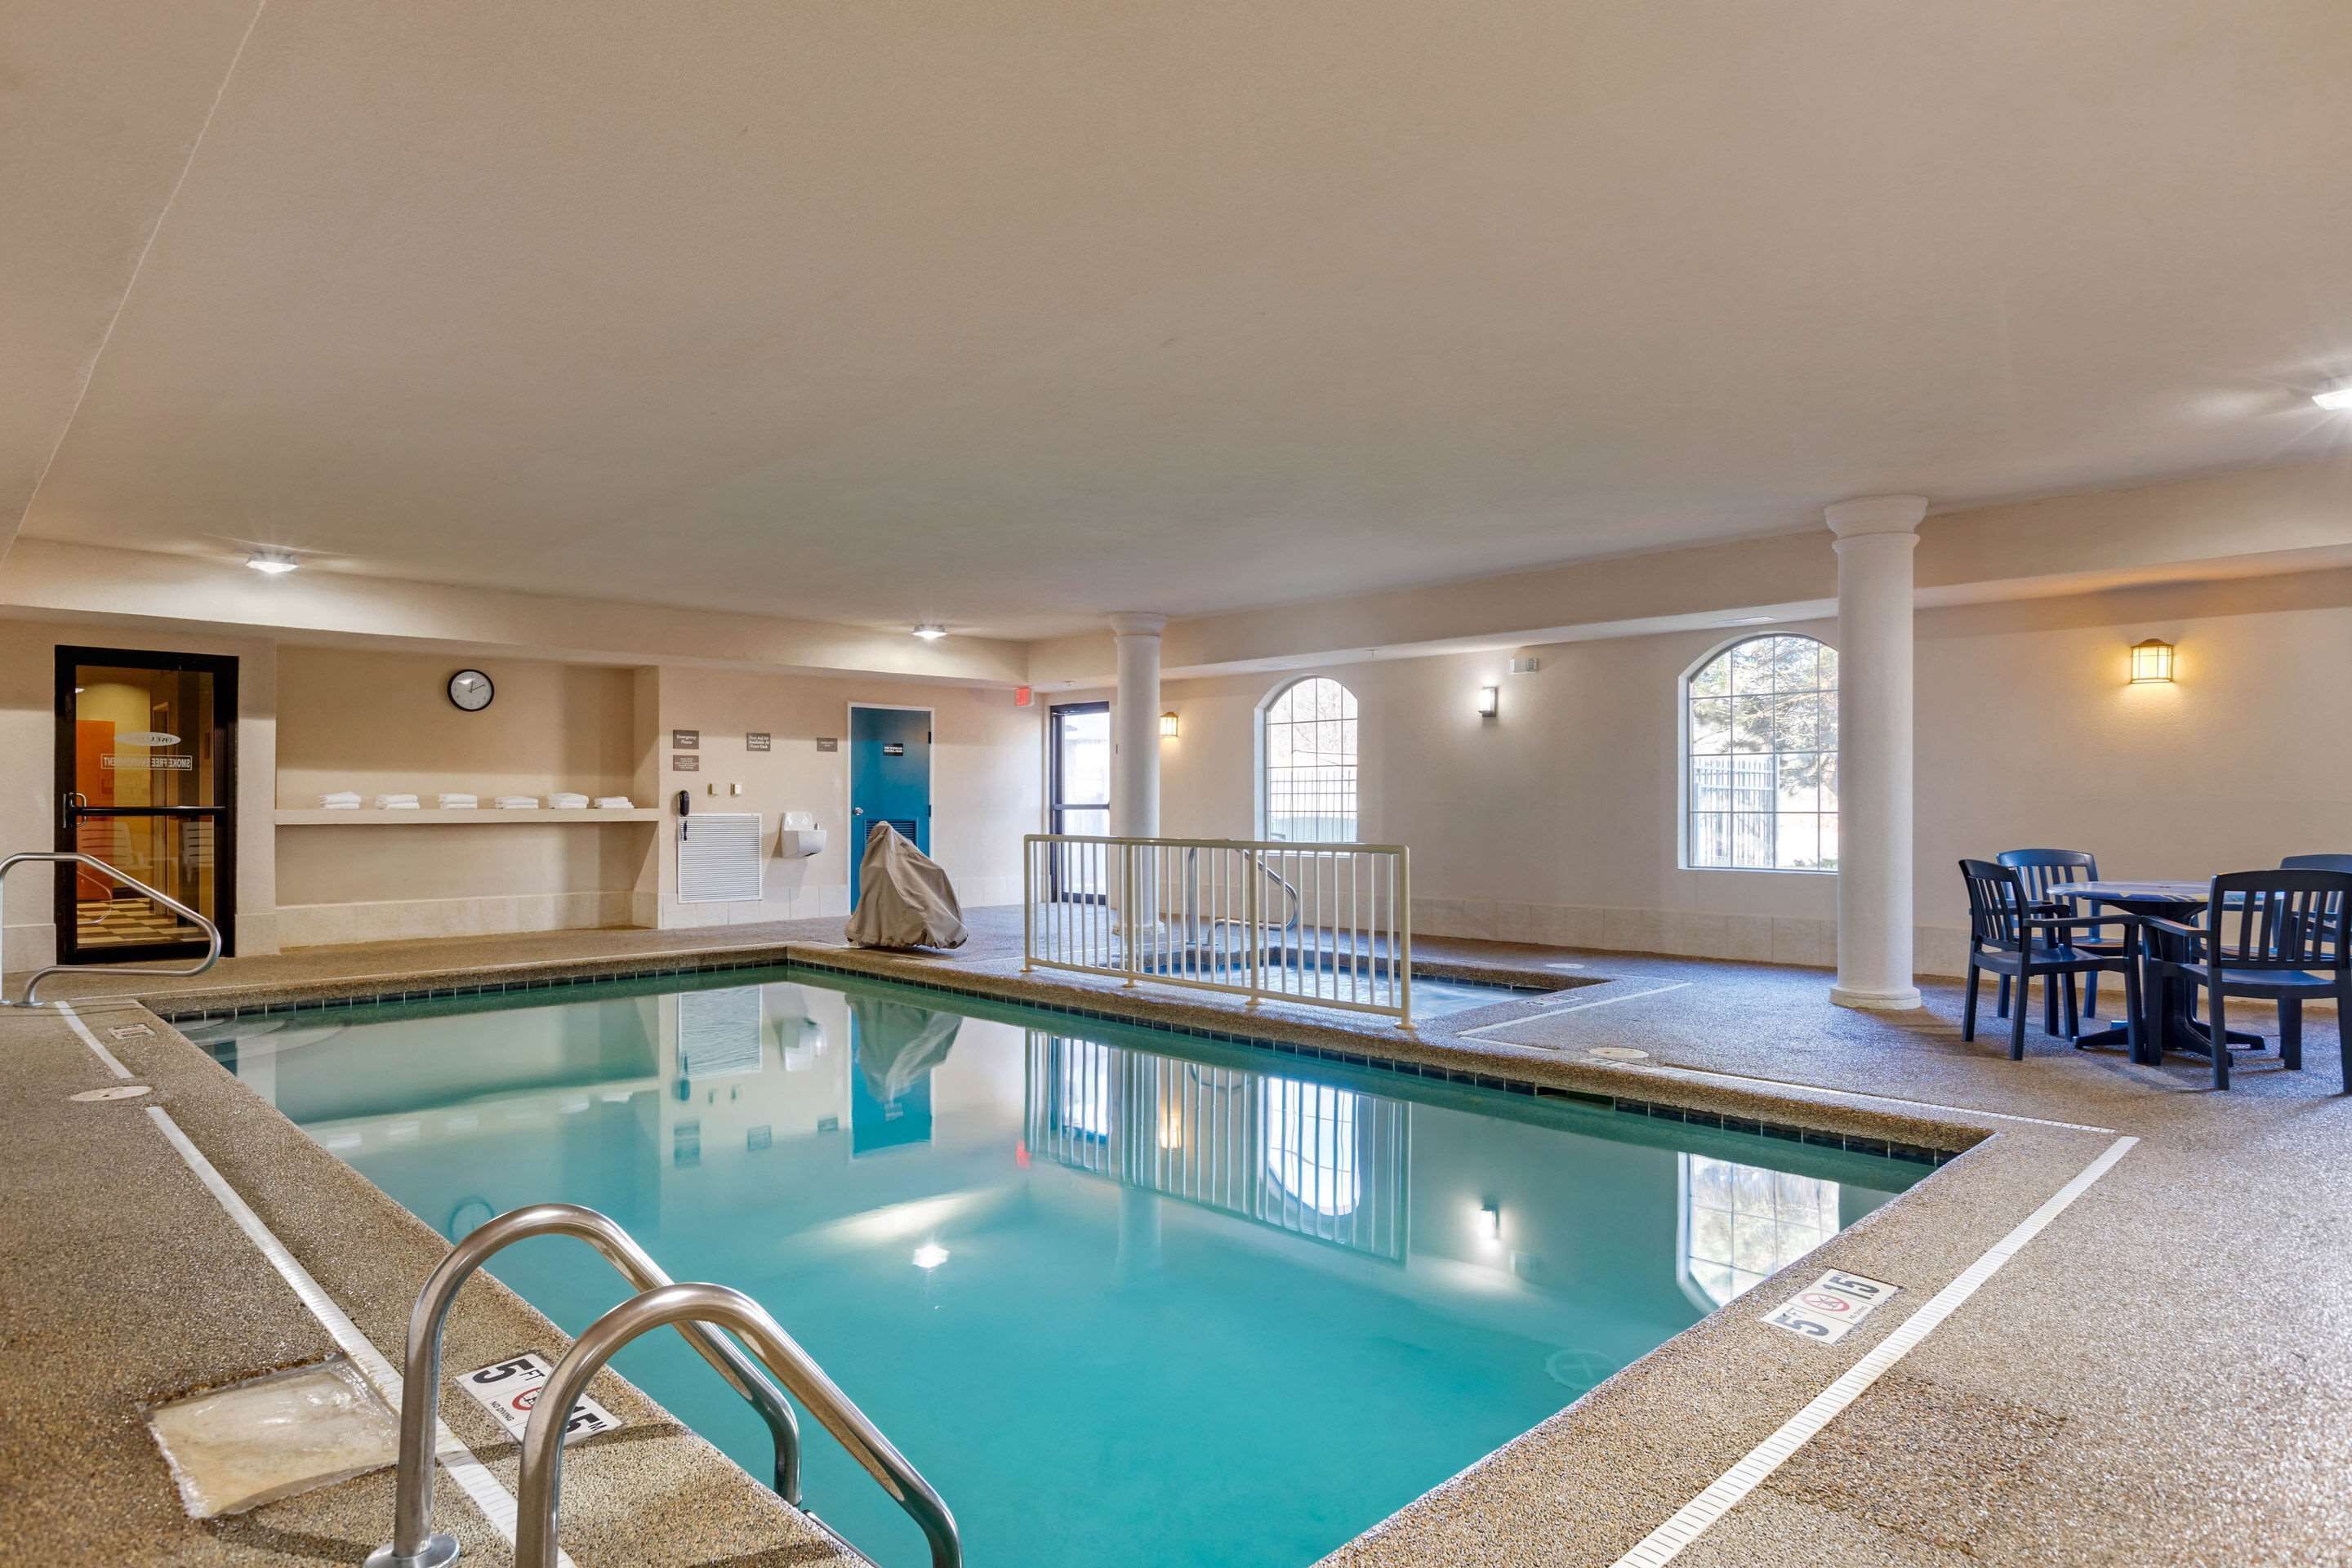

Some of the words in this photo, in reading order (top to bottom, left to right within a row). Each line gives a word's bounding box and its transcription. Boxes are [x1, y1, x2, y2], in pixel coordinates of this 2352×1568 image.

[1822, 1276, 1880, 1299] 1.5
[1773, 1313, 1829, 1336] 5
[473, 1358, 535, 1383] 5
[519, 1368, 546, 1381] FT
[490, 1401, 501, 1409] NO
[496, 1406, 514, 1421] DIVING
[587, 1421, 608, 1432] M
